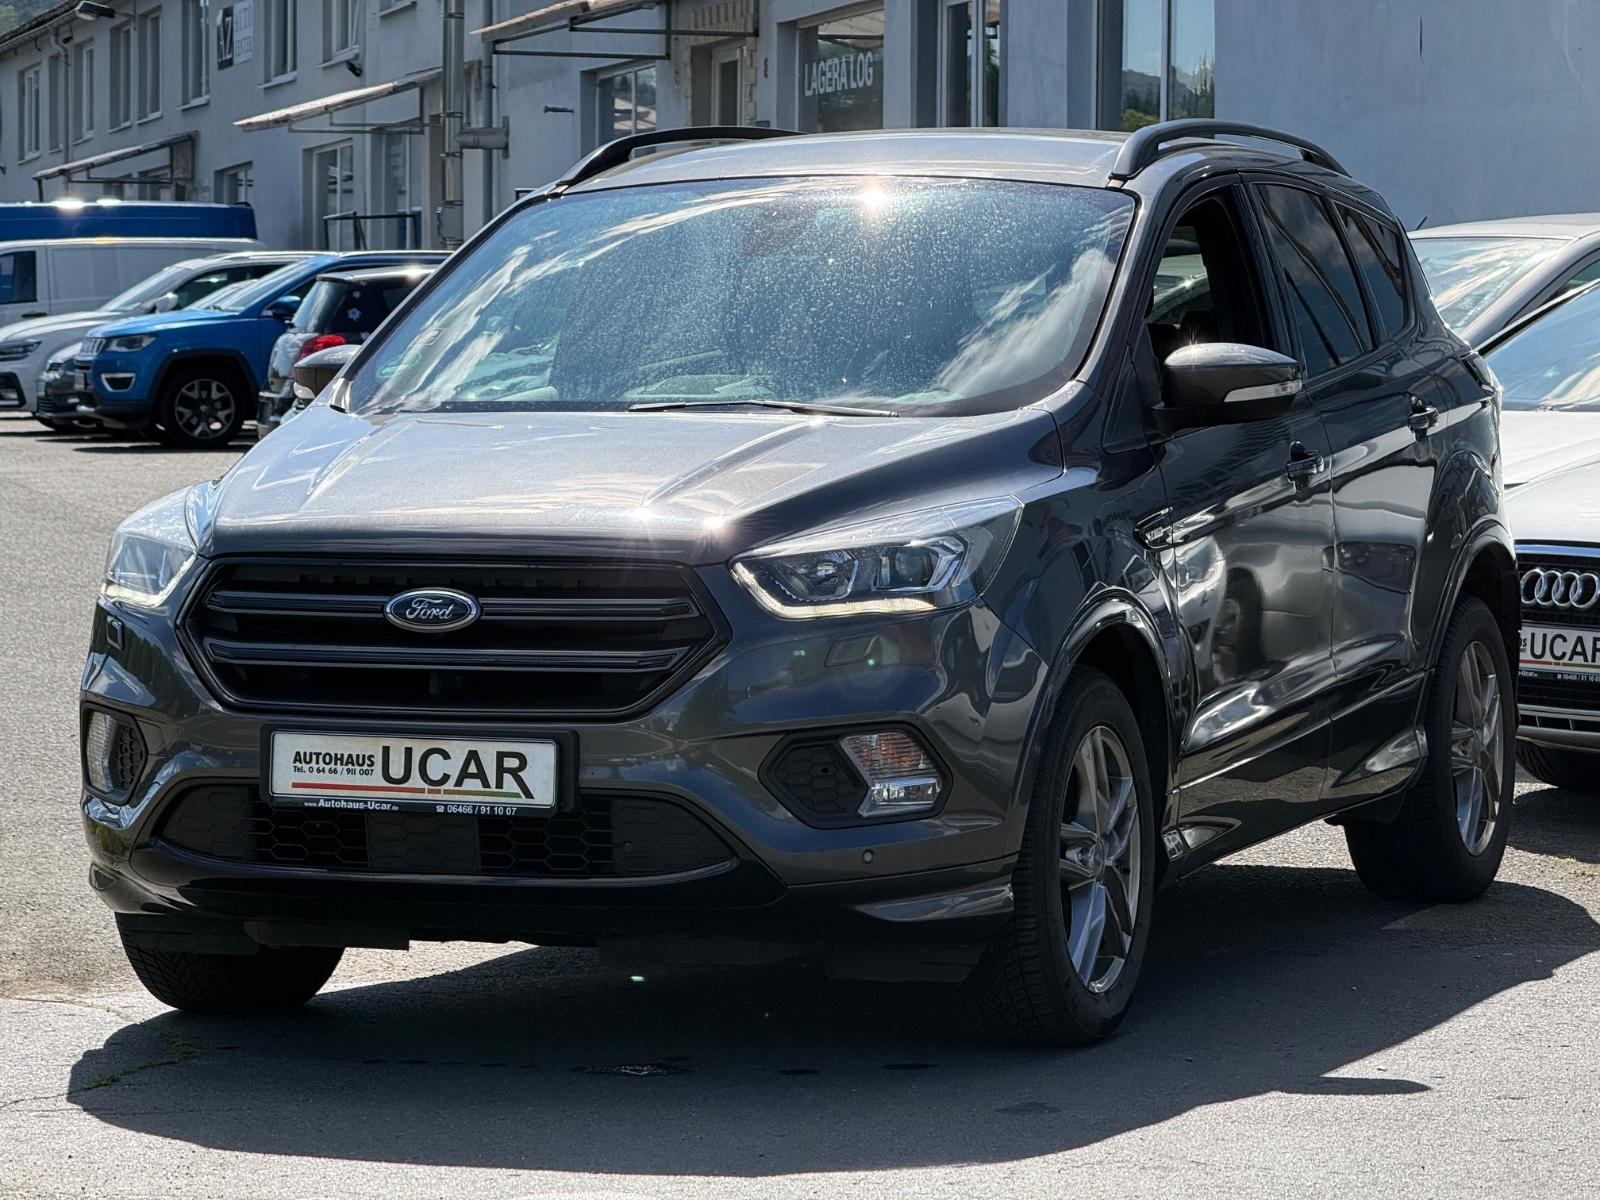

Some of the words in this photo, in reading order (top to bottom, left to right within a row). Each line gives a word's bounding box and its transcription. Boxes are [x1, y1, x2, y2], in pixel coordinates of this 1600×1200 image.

[406, 598, 454, 620] Ford
[293, 751, 375, 768] AUTOHAUS
[381, 746, 535, 799] UCAR
[447, 805, 473, 814] 06466
[480, 806, 490, 815] 91
[494, 807, 503, 815] 10
[506, 807, 517, 815] 07
